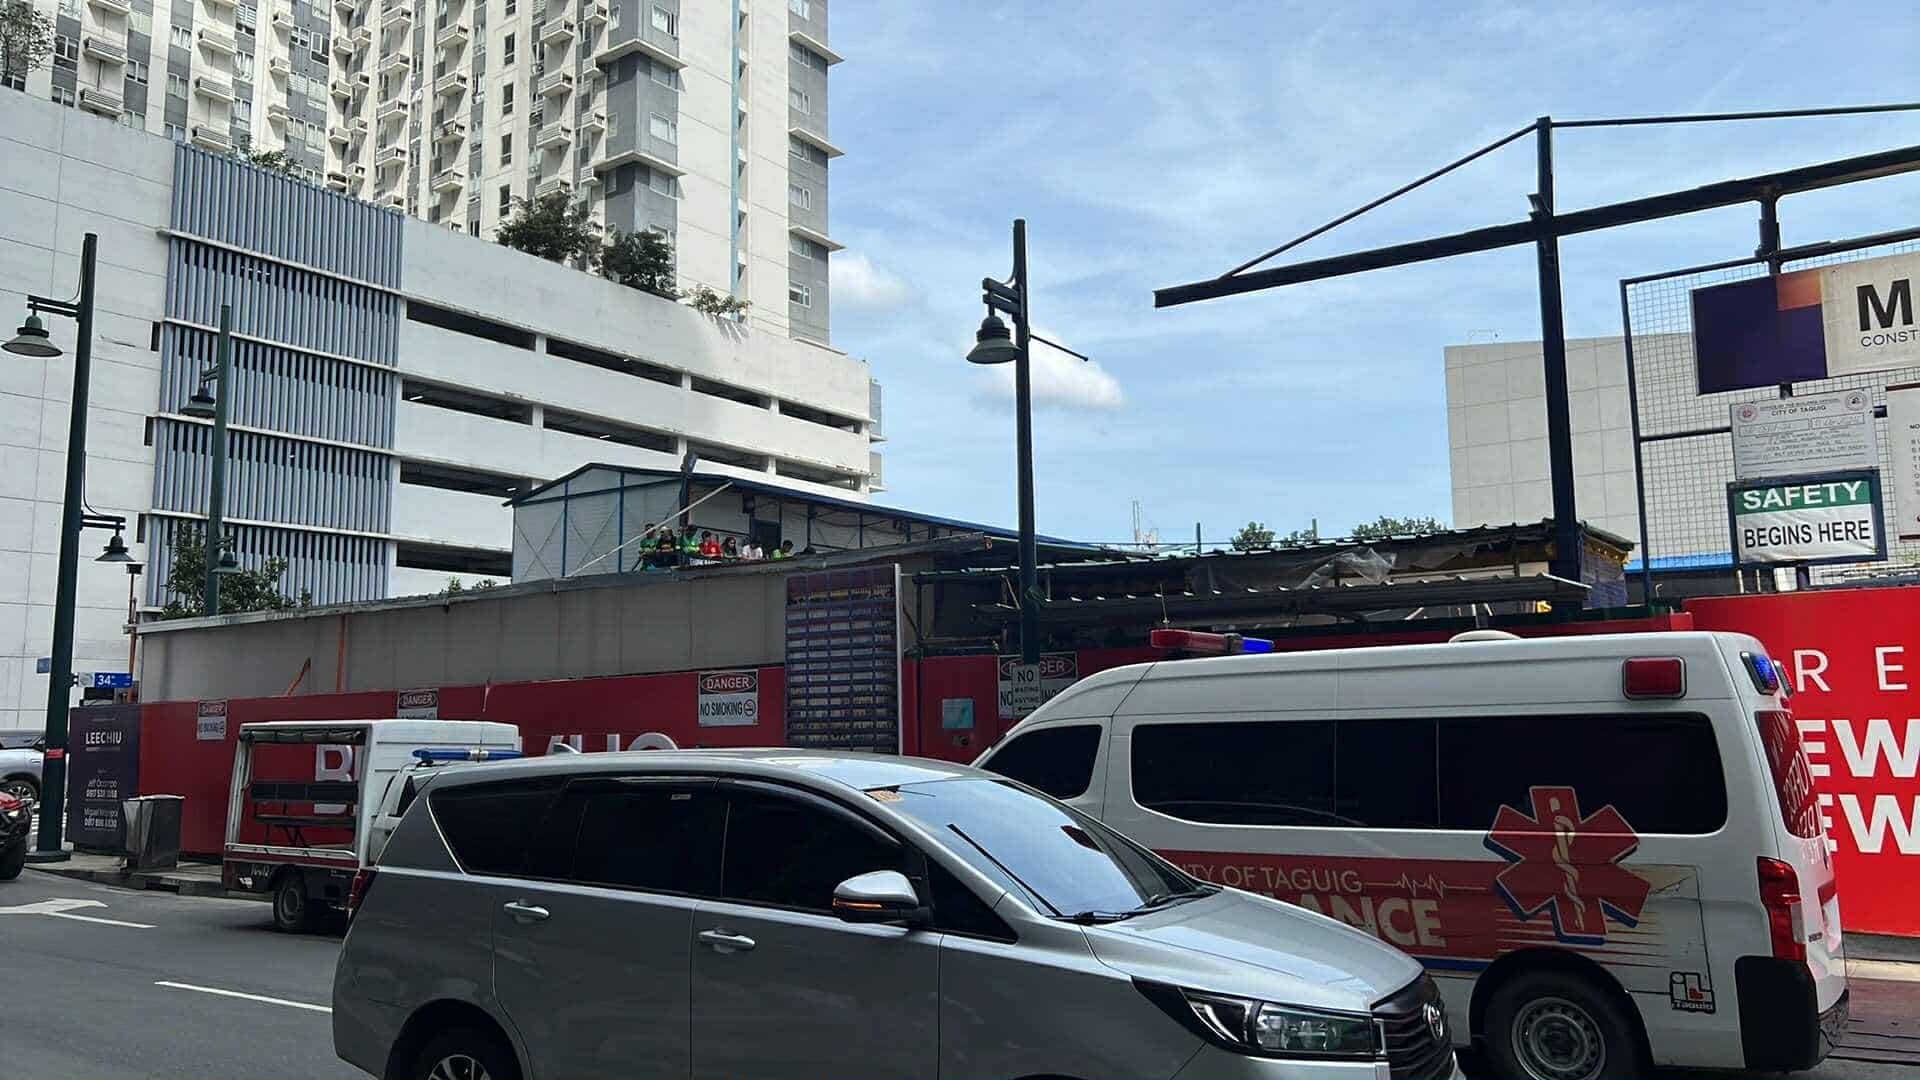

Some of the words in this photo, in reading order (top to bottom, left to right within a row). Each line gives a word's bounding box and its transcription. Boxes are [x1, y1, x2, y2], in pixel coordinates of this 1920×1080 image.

[1856, 279, 1914, 331] M
[1743, 480, 1862, 509] SAFETY
[1744, 524, 1812, 548] BEGINS
[1818, 520, 1871, 542] HERE
[97, 674, 111, 685] 34
[706, 676, 750, 689] DANGER
[1017, 670, 1034, 682] NO
[401, 693, 434, 705] DANGER
[1000, 690, 1013, 706] NO
[700, 703, 710, 716] NO
[711, 701, 743, 716] SMOKING
[85, 731, 122, 745] LEECHIU
[1222, 865, 1256, 887] OF
[1260, 866, 1363, 893] TAGUIG
